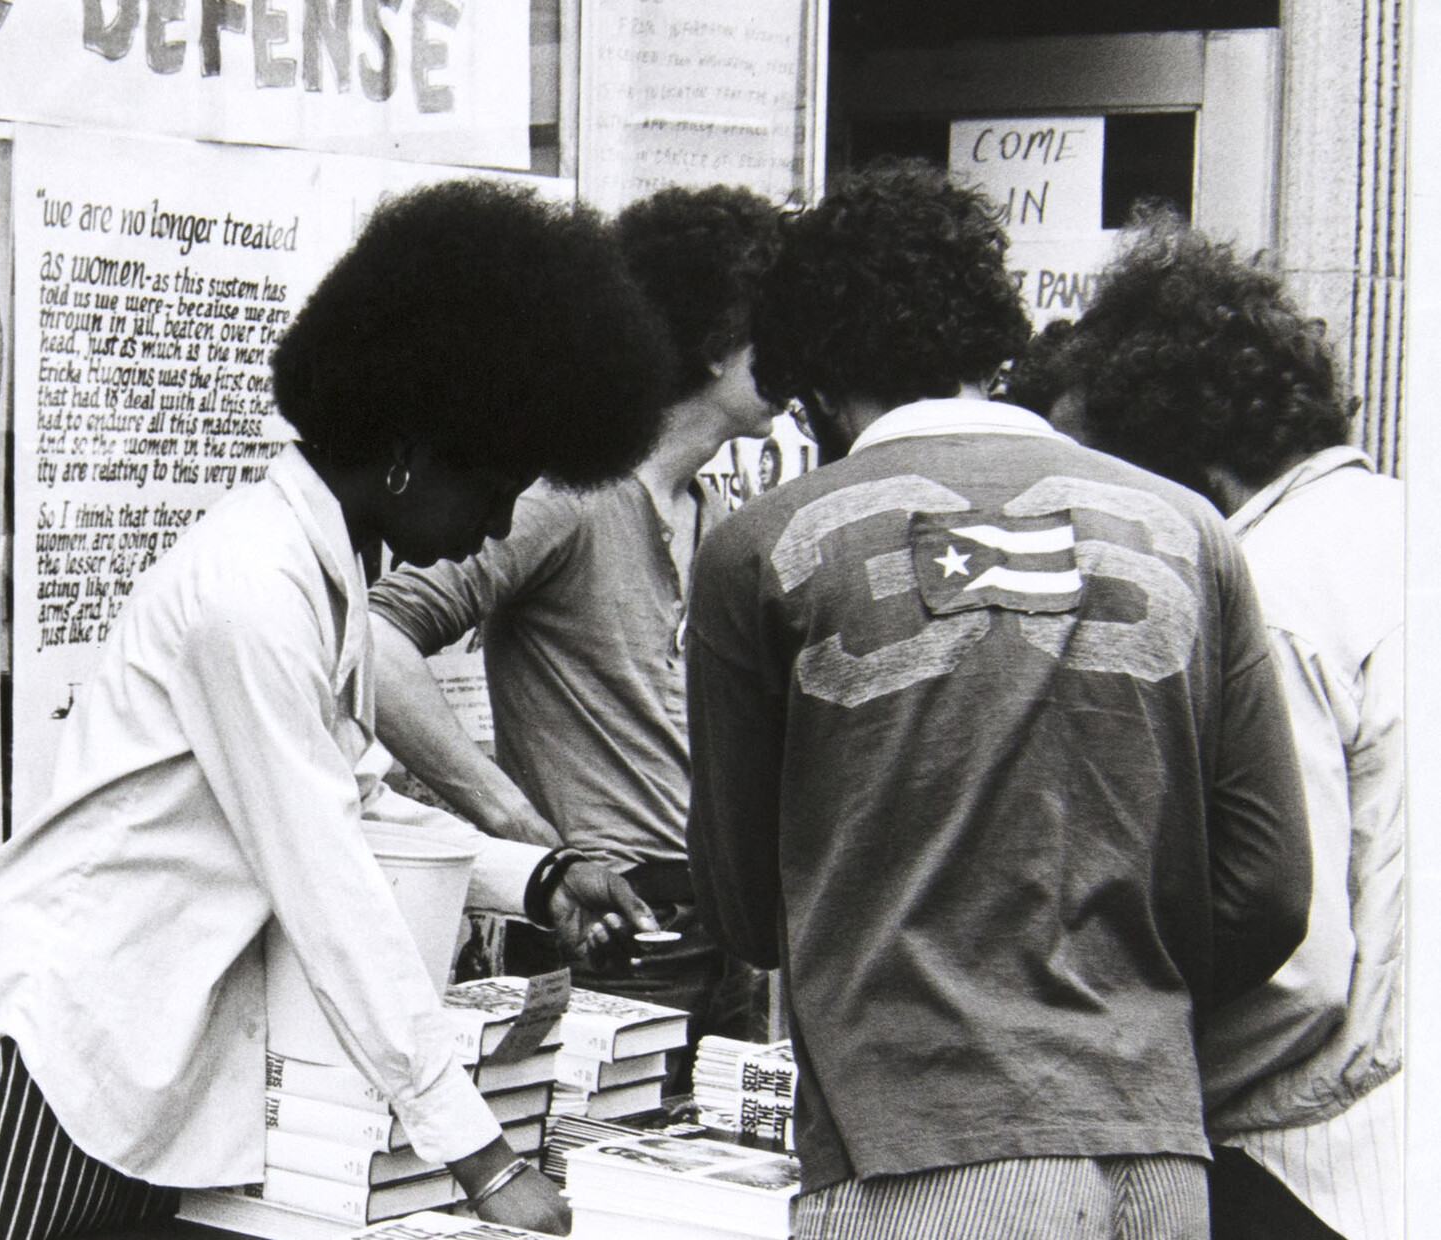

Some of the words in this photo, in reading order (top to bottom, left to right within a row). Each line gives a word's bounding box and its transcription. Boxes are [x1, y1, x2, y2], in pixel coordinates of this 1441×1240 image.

[973, 127, 1086, 165] COME
[1006, 181, 1049, 225] IN
[79, 202, 112, 233] are
[120, 207, 146, 236] no
[150, 199, 217, 255] longer
[222, 212, 299, 251] treated
[40, 251, 64, 281] as
[175, 266, 203, 295] this
[262, 275, 287, 302] has
[40, 284, 69, 306] told
[73, 290, 90, 309] us
[95, 291, 118, 310] we
[177, 297, 240, 321] because
[245, 306, 266, 322] we
[266, 306, 290, 325] are
[39, 307, 102, 334] thrown
[110, 311, 126, 334] in
[163, 312, 214, 341] beaten
[220, 322, 256, 344] over
[87, 333, 119, 361] just
[120, 336, 137, 360] as
[142, 337, 181, 361] much
[185, 342, 201, 362] as
[207, 342, 230, 363] the
[235, 346, 264, 366] men
[38, 356, 81, 385] Ericka
[87, 357, 154, 394] Huggins
[159, 367, 186, 389] was
[190, 365, 211, 390] the
[215, 365, 245, 392] first
[38, 384, 68, 408] that
[72, 387, 101, 410] had
[105, 386, 119, 410] to
[123, 389, 155, 412] deal
[160, 390, 195, 413] with
[199, 388, 218, 413] all
[66, 411, 81, 432] to
[87, 411, 145, 434] endure
[147, 410, 165, 434] all
[169, 412, 198, 436] this
[37, 432, 66, 455] And
[74, 437, 88, 455] so
[92, 433, 116, 455] the
[123, 435, 178, 457] women
[184, 437, 199, 457] in
[204, 436, 226, 459] the
[38, 459, 57, 488] ity
[62, 461, 88, 483] are
[92, 457, 147, 489] relating
[153, 459, 168, 481] to
[172, 459, 199, 485] this
[204, 464, 238, 490] very
[37, 502, 56, 530] So
[60, 499, 70, 529] I
[76, 502, 114, 530] think
[119, 502, 149, 528] that
[153, 501, 192, 528] these
[119, 530, 158, 556] going
[162, 529, 177, 550] to
[38, 554, 59, 576] the
[65, 552, 105, 576] lesser
[109, 551, 138, 578] half
[37, 578, 80, 606] acting
[85, 576, 110, 599] like
[113, 576, 134, 599] the
[37, 624, 66, 653] just
[69, 621, 94, 644] like
[273, 1057, 286, 1089] SEALE
[742, 1062, 758, 1093] SEIZE
[758, 1068, 776, 1092] THE
[775, 1068, 793, 1099] TIME
[268, 1098, 281, 1128] SEALE
[741, 1096, 758, 1129] SEIZE
[757, 1104, 775, 1127] THE
